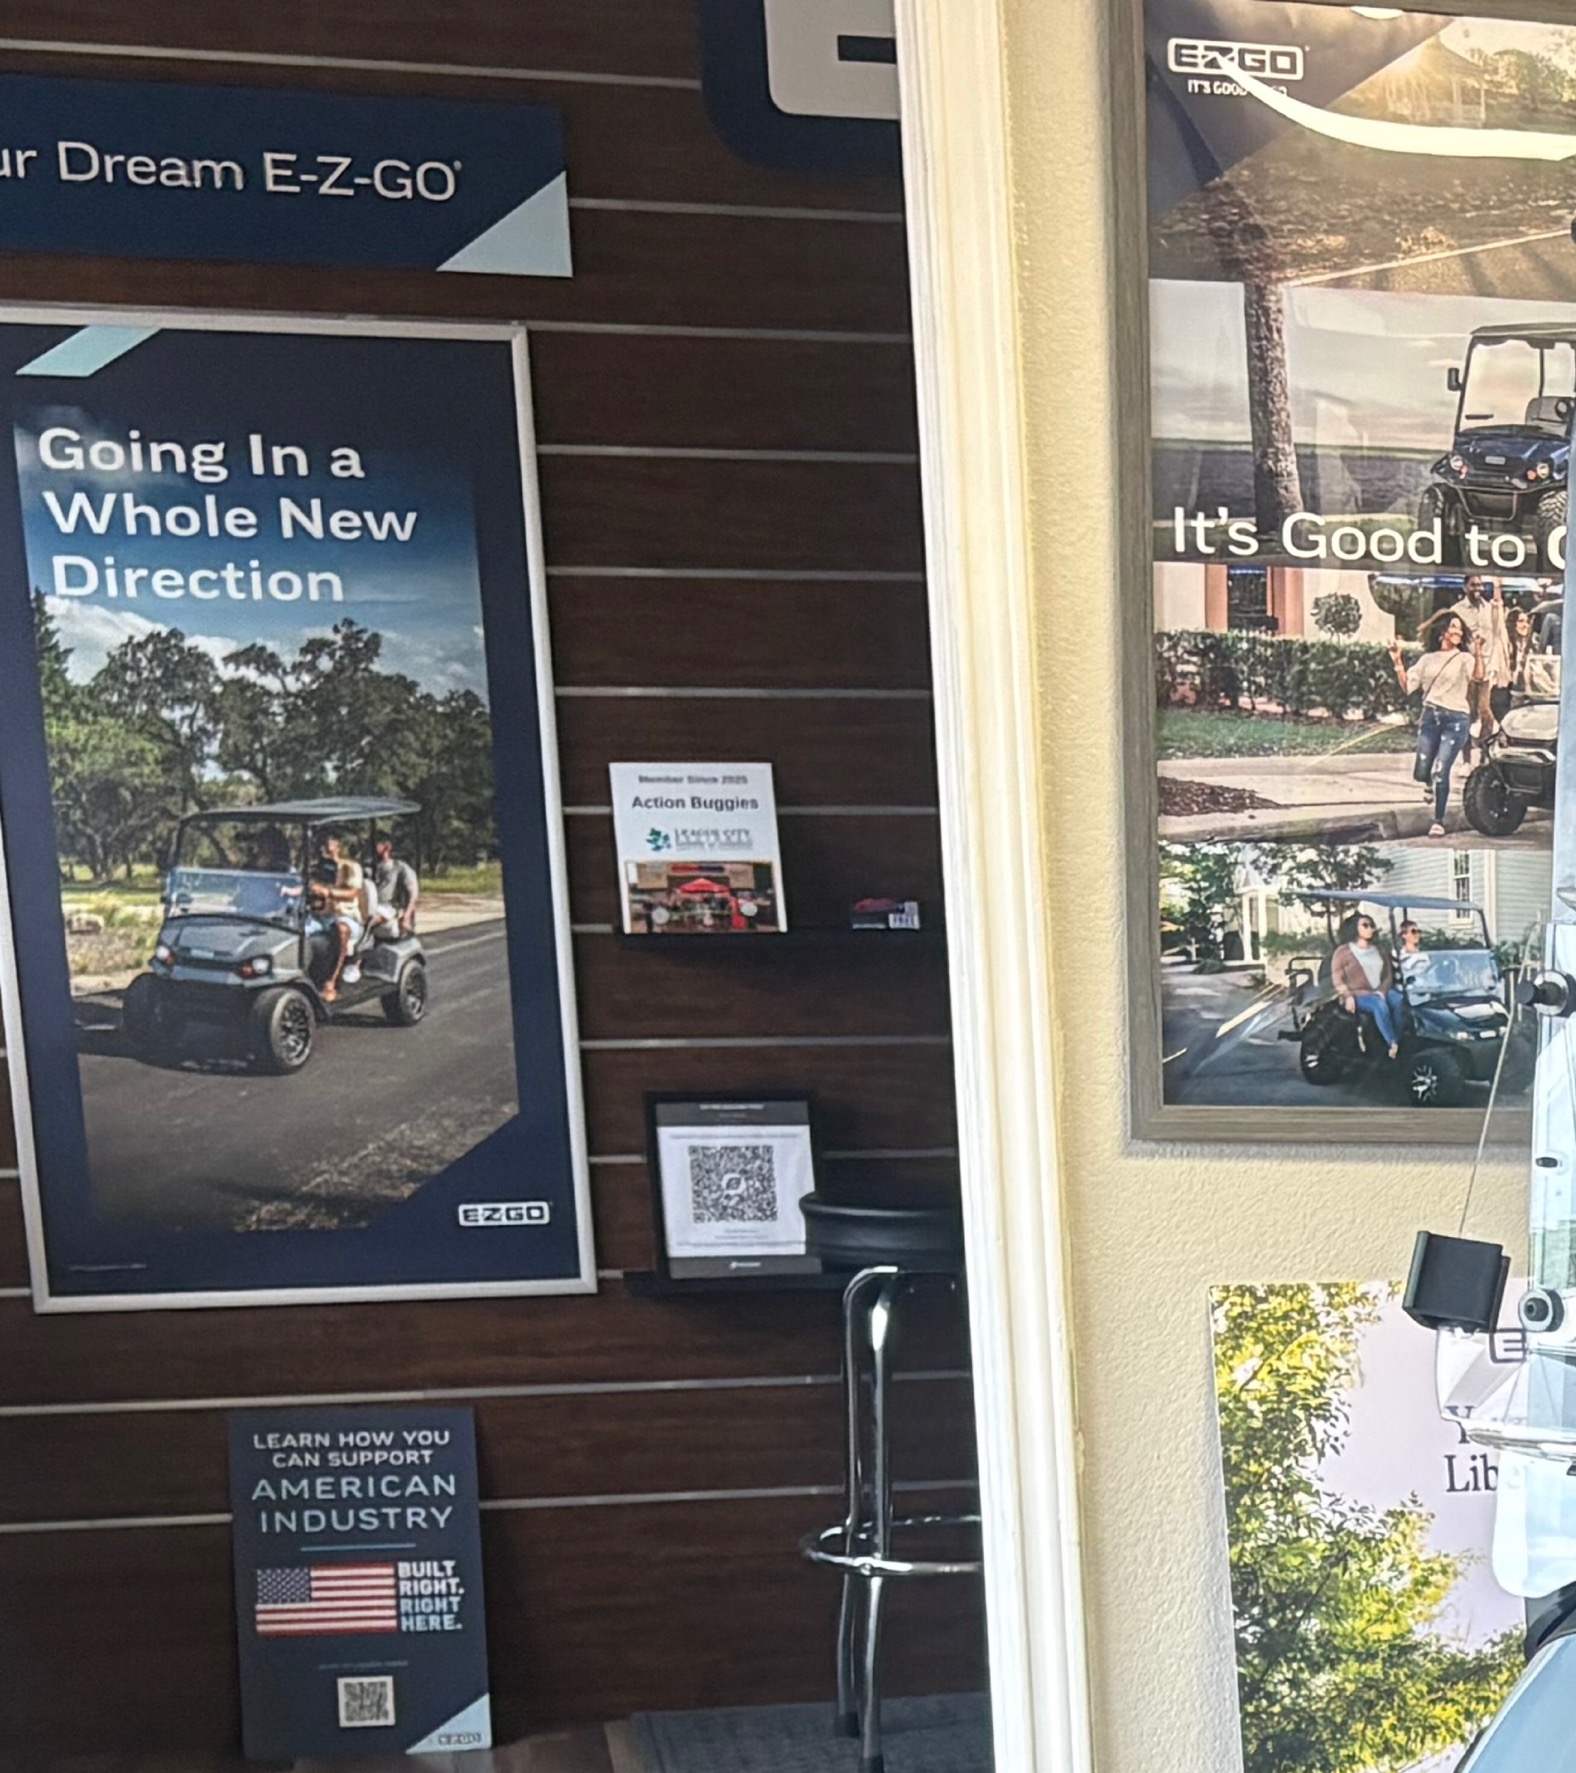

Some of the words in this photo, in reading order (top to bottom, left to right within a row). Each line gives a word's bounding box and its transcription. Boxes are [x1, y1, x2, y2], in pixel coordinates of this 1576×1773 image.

[58, 141, 244, 190] Dream
[38, 427, 227, 482] Going
[250, 434, 308, 477] In
[330, 447, 366, 479] a
[43, 491, 259, 540] Whole
[280, 497, 418, 542] New
[1173, 505, 1260, 556] It's
[1281, 512, 1444, 566] Good
[1469, 523, 1527, 568] to
[52, 554, 345, 603] Direction
[632, 796, 686, 810] Action
[691, 796, 759, 812] Buggies
[461, 1204, 547, 1225] EZGO
[253, 1432, 331, 1449] LEARN
[338, 1431, 394, 1447] HOW
[402, 1430, 450, 1446] YOU
[272, 1452, 320, 1468] CAN
[328, 1449, 434, 1467] SUPPORT
[252, 1474, 456, 1501] AMERICAN
[260, 1506, 453, 1533] INDUSTRY
[398, 1560, 456, 1578] BUILT
[399, 1577, 465, 1596] RIGHT.
[400, 1596, 462, 1614] RIGHT
[401, 1614, 463, 1632] HERE.
